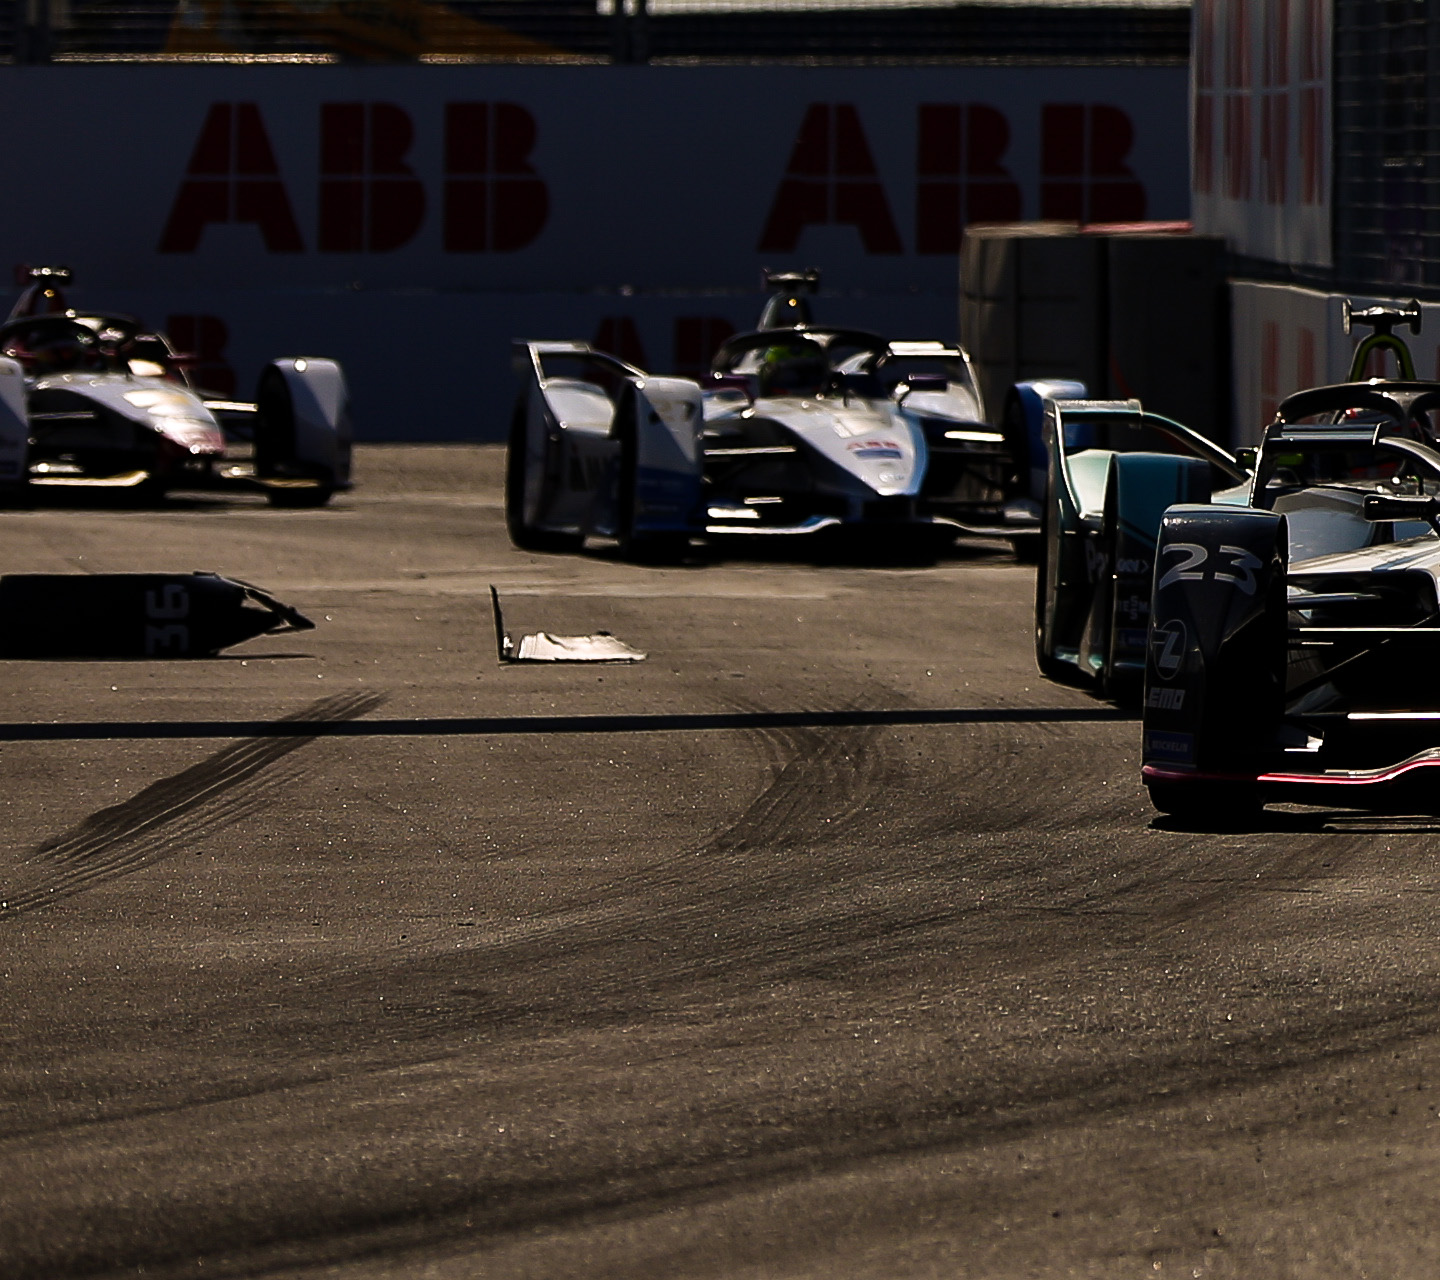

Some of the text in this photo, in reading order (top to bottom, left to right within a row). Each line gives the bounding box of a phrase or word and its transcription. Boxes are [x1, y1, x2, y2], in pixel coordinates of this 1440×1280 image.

[159, 102, 549, 253] ABB
[760, 102, 1147, 253] ABB
[1158, 543, 1264, 596] 23
[1146, 686, 1187, 711] EMO
